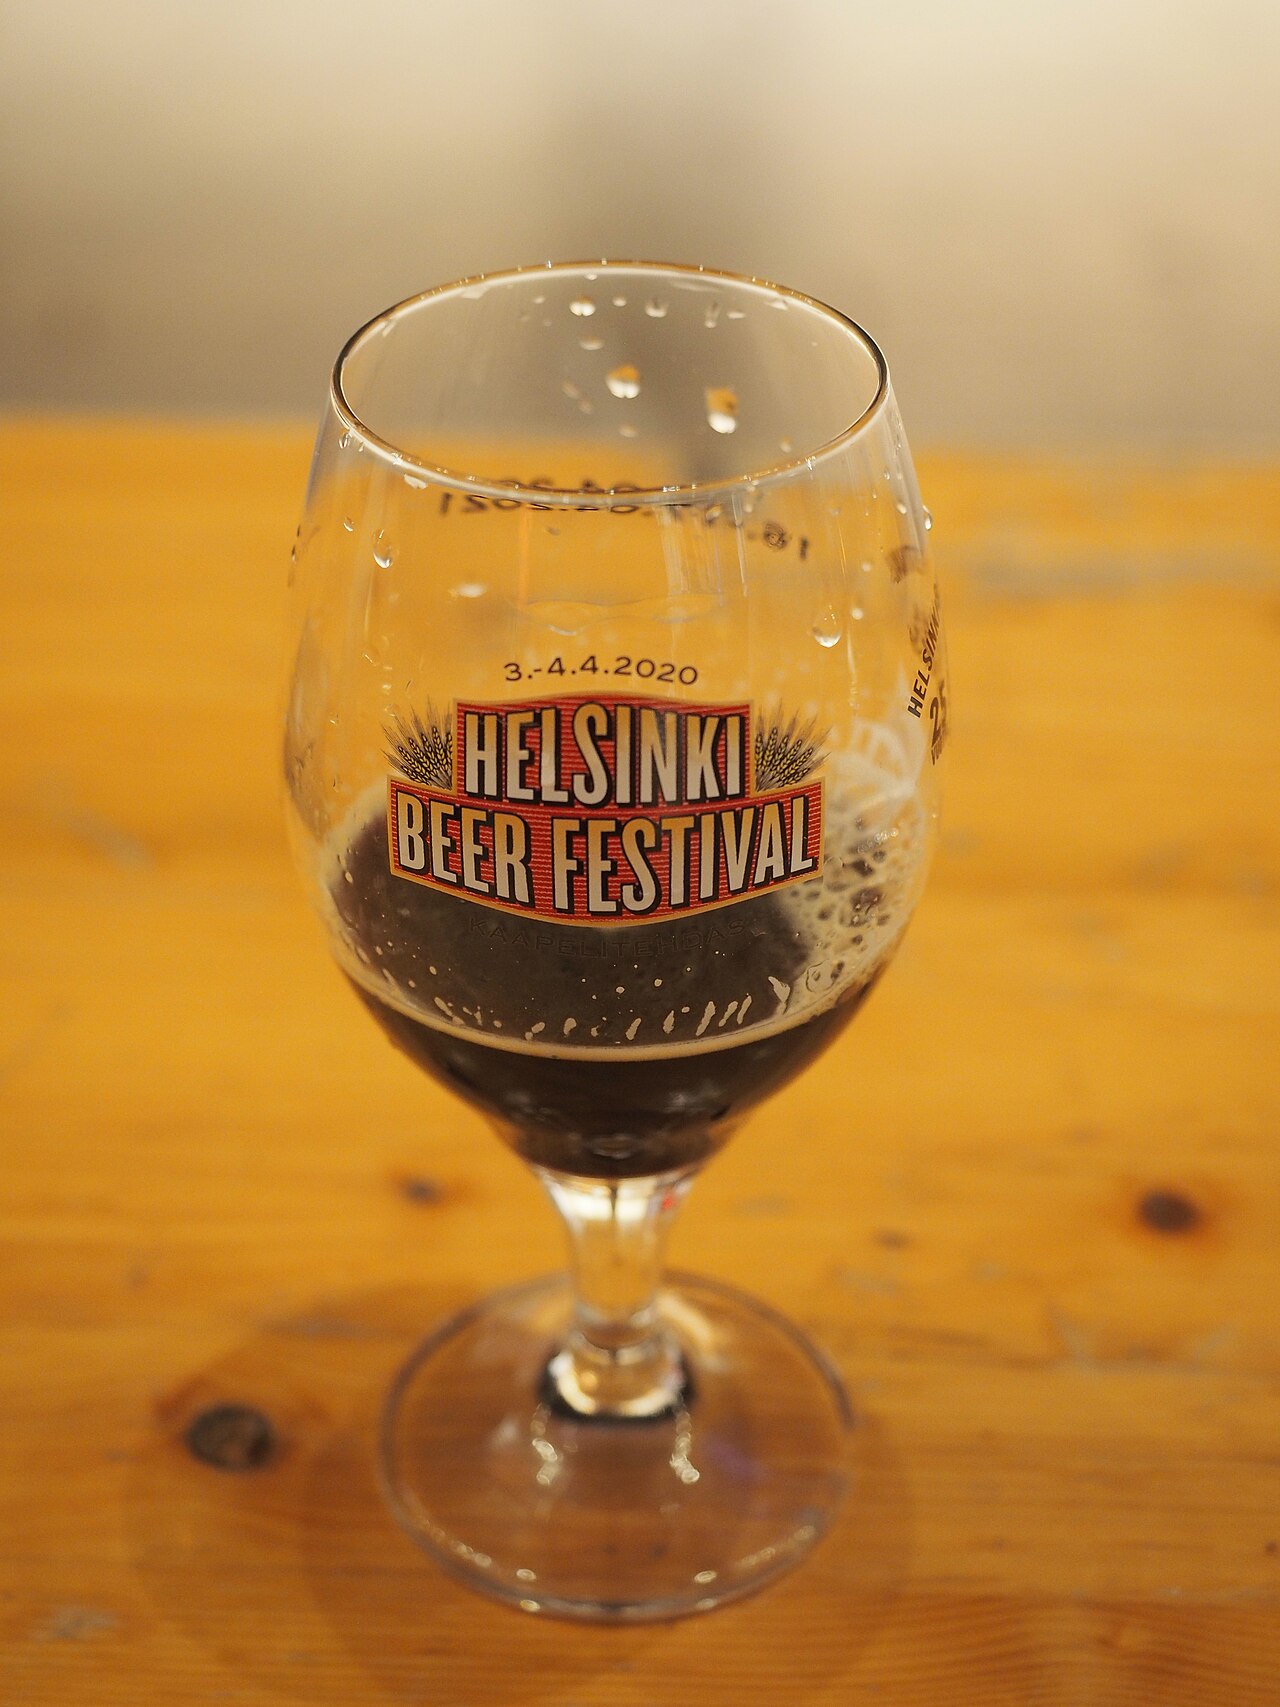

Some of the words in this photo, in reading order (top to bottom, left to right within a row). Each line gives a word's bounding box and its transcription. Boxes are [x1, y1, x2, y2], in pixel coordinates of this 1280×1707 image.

[504, 655, 698, 685] 3.-4.4.2020
[464, 701, 742, 808] HELSINKI
[395, 791, 532, 904] BEER
[550, 794, 819, 916] FESTIVAL
